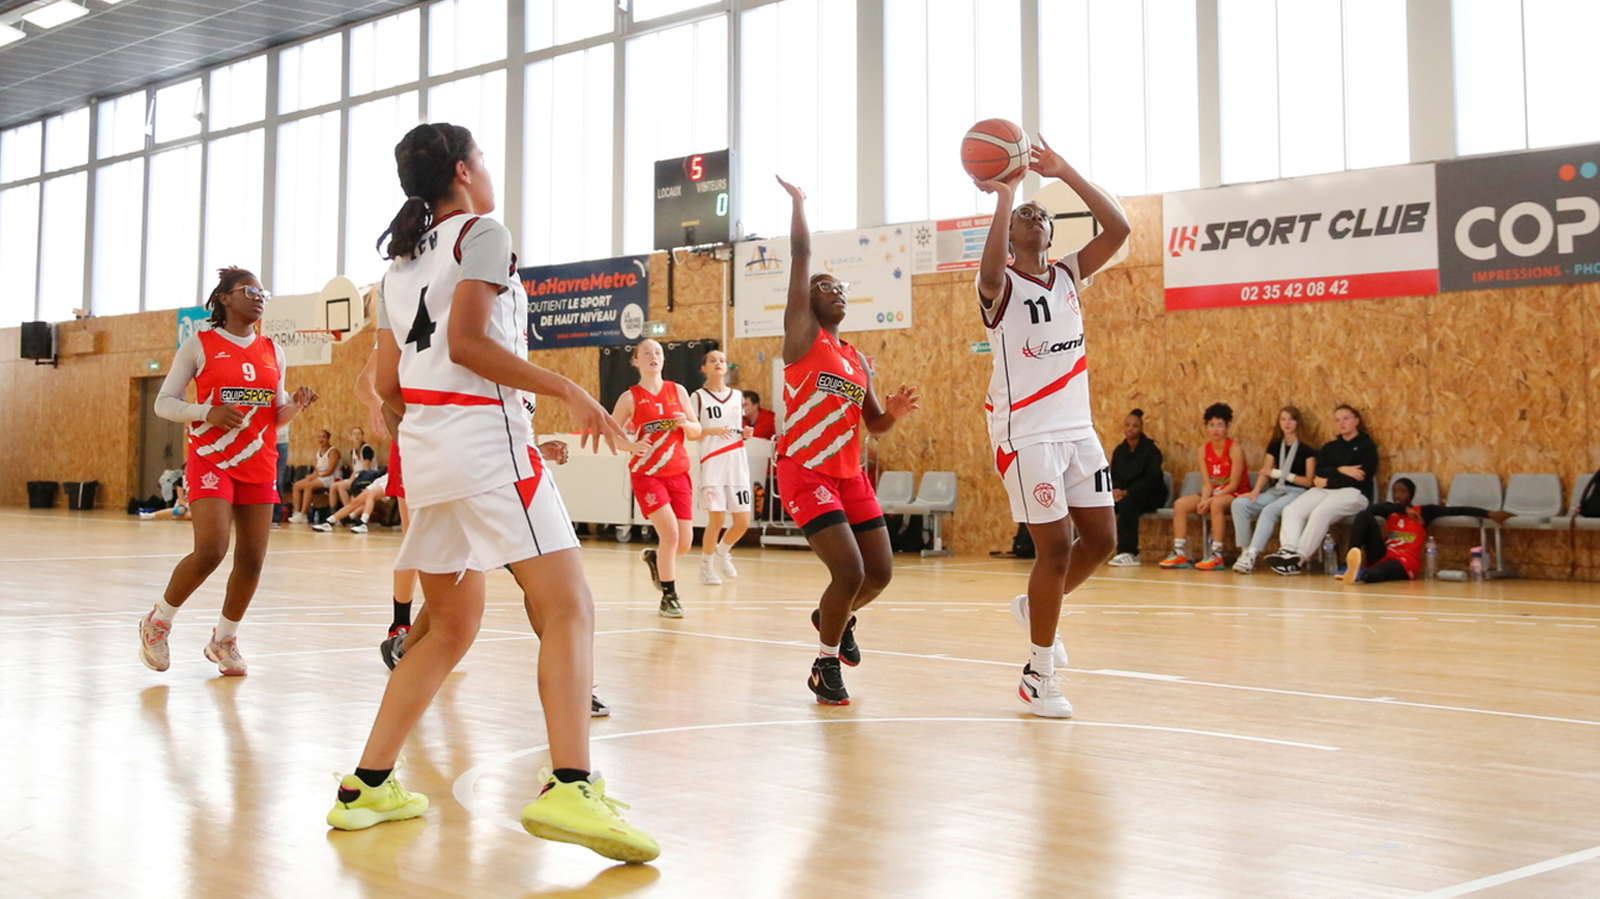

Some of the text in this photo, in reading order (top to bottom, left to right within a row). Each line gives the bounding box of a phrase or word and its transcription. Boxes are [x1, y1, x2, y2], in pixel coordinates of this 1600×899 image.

[691, 156, 703, 180] 5
[657, 178, 727, 199] LOCAUX VISITEURS
[716, 193, 728, 217] 0
[1200, 212, 1322, 252] SPORT
[1328, 202, 1431, 240] CLUB
[1454, 196, 1600, 261] COP
[1472, 265, 1562, 282] IMPRESSIONS
[1241, 279, 1349, 301] 02 35 42 08 42
[527, 295, 612, 313] SOUTIENT LE SPORT
[1024, 295, 1052, 325] 11
[405, 283, 437, 353] 4
[540, 309, 617, 327] DE HAUT NIVEAU
[241, 362, 256, 382] 9
[655, 403, 664, 415] 7
[706, 406, 722, 419] 10
[736, 490, 750, 505] 10
